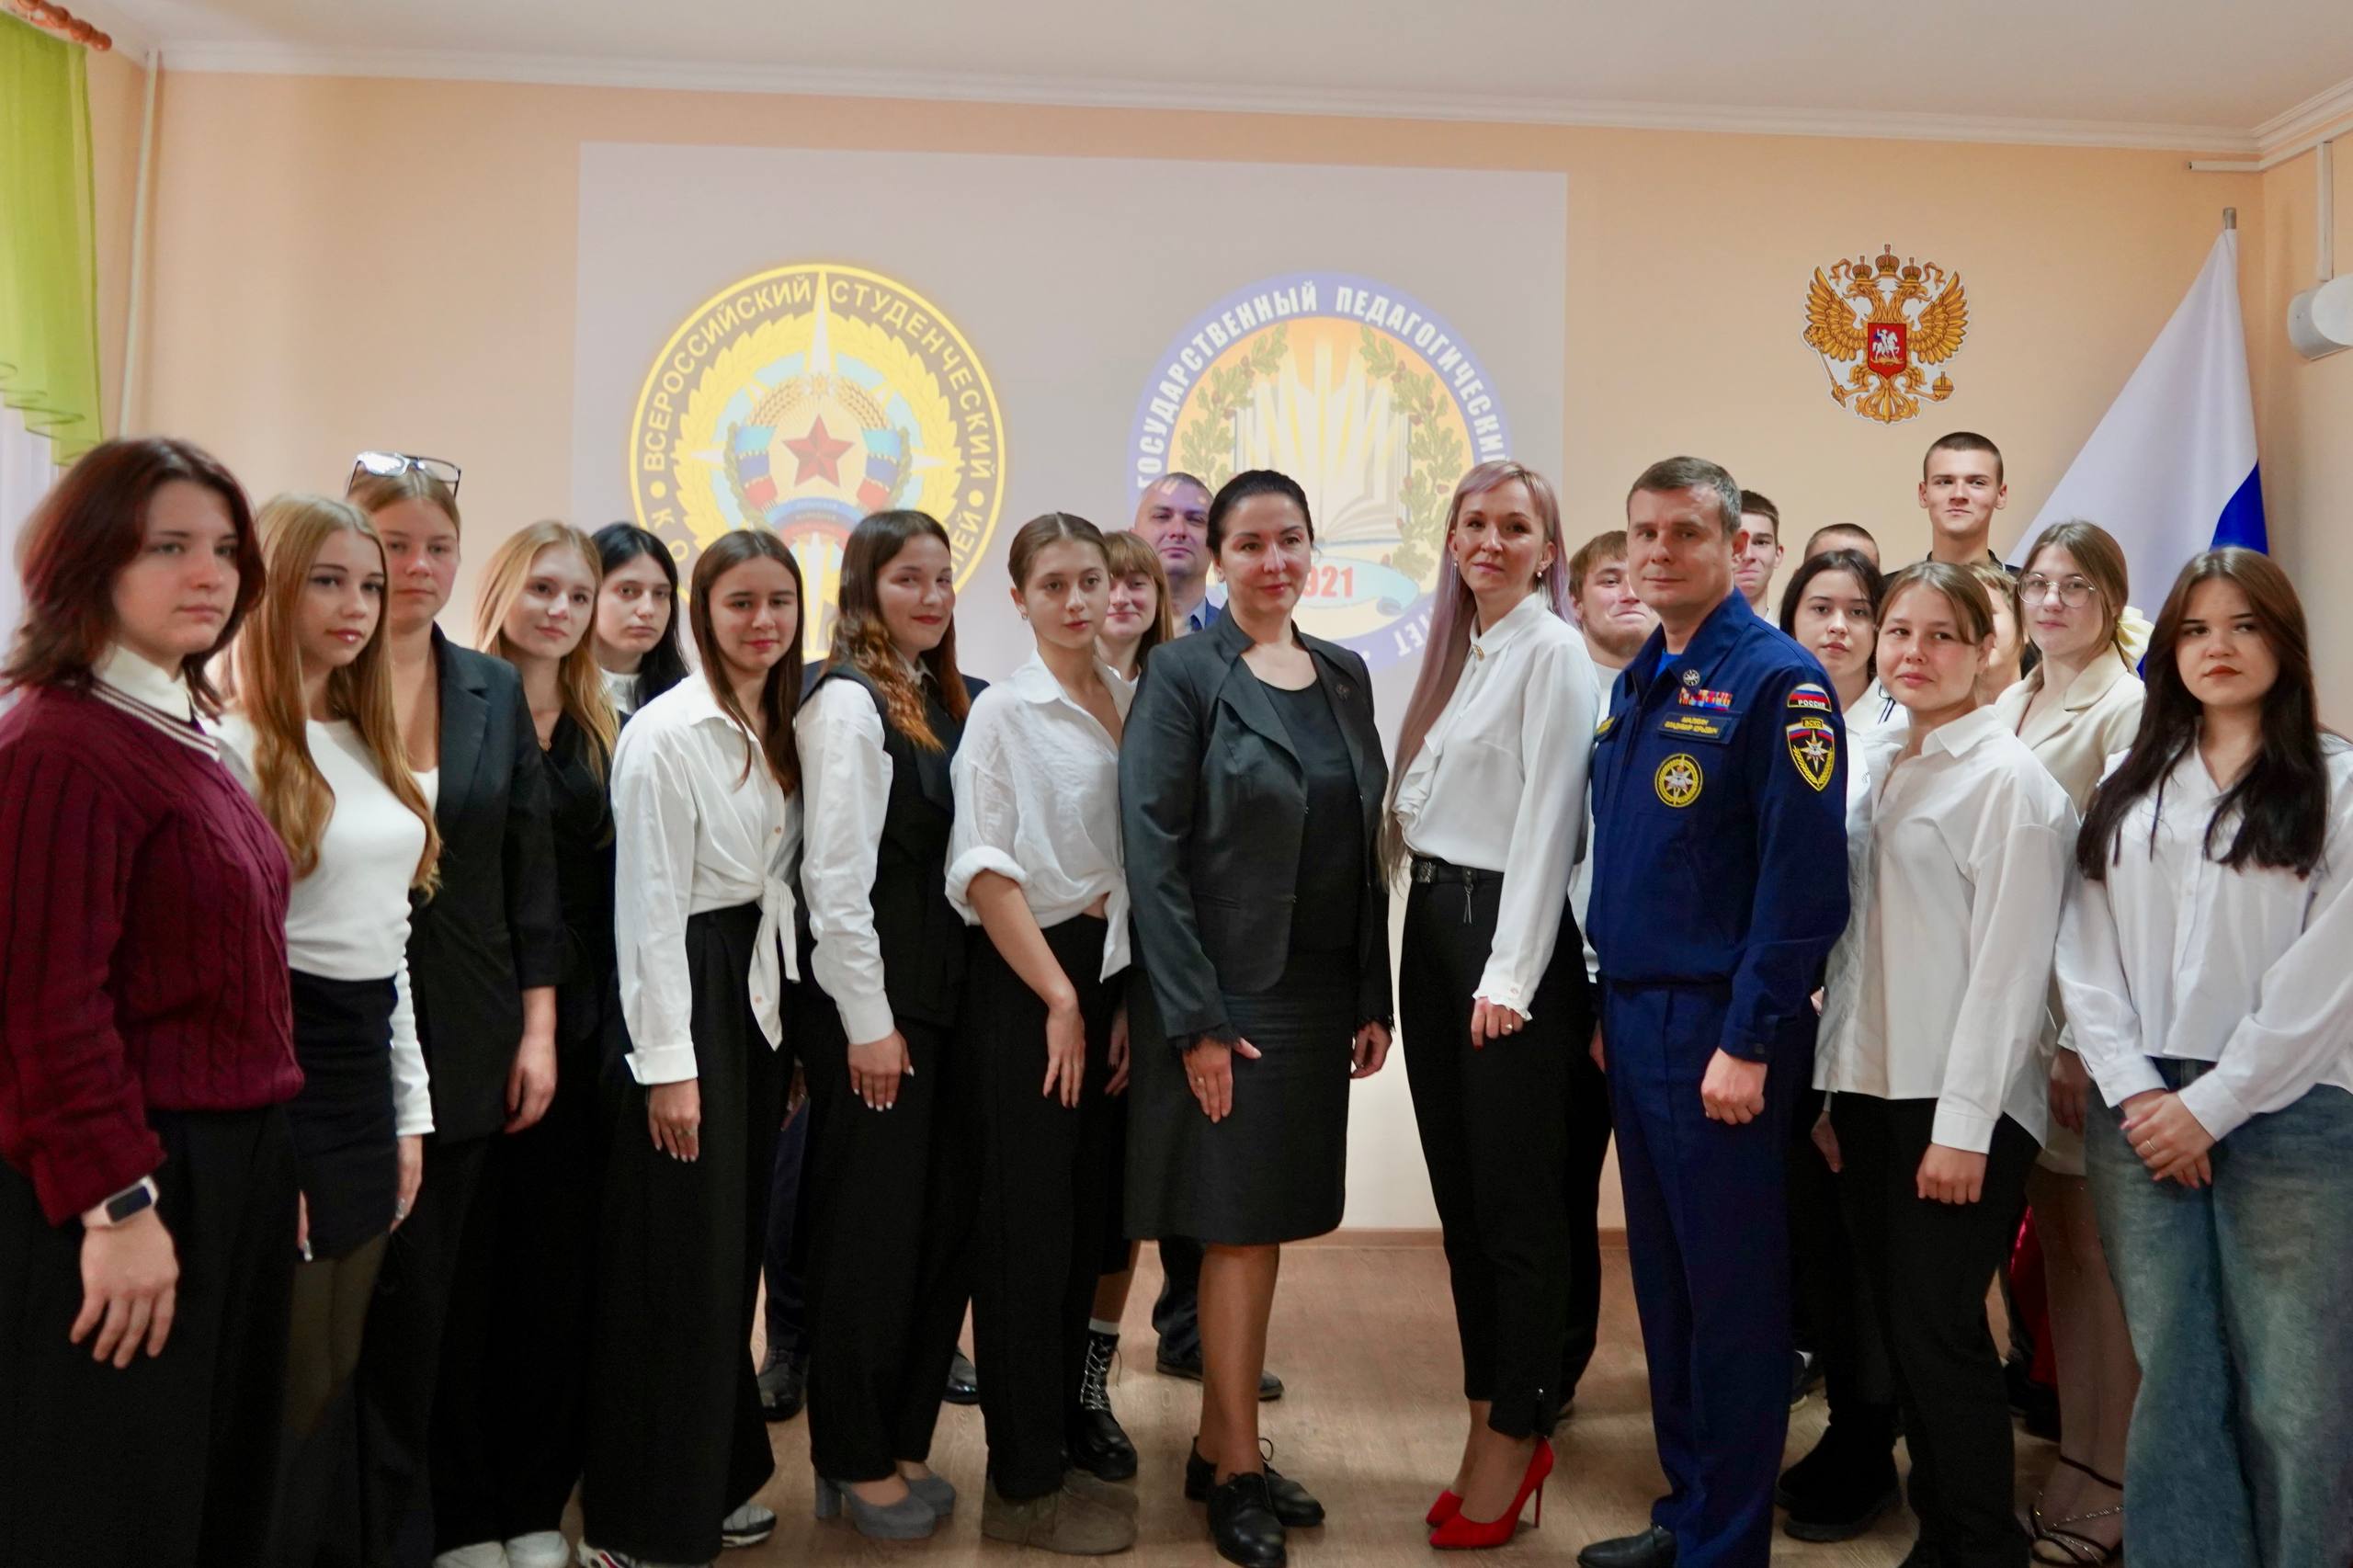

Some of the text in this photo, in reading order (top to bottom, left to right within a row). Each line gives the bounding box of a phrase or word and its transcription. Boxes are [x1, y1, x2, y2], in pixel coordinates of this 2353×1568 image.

[644, 275, 995, 480] ВСЕРОССИЙСКИЙ СТУДЕНЧЕСКИЙ
[1302, 564, 1354, 598] 921
